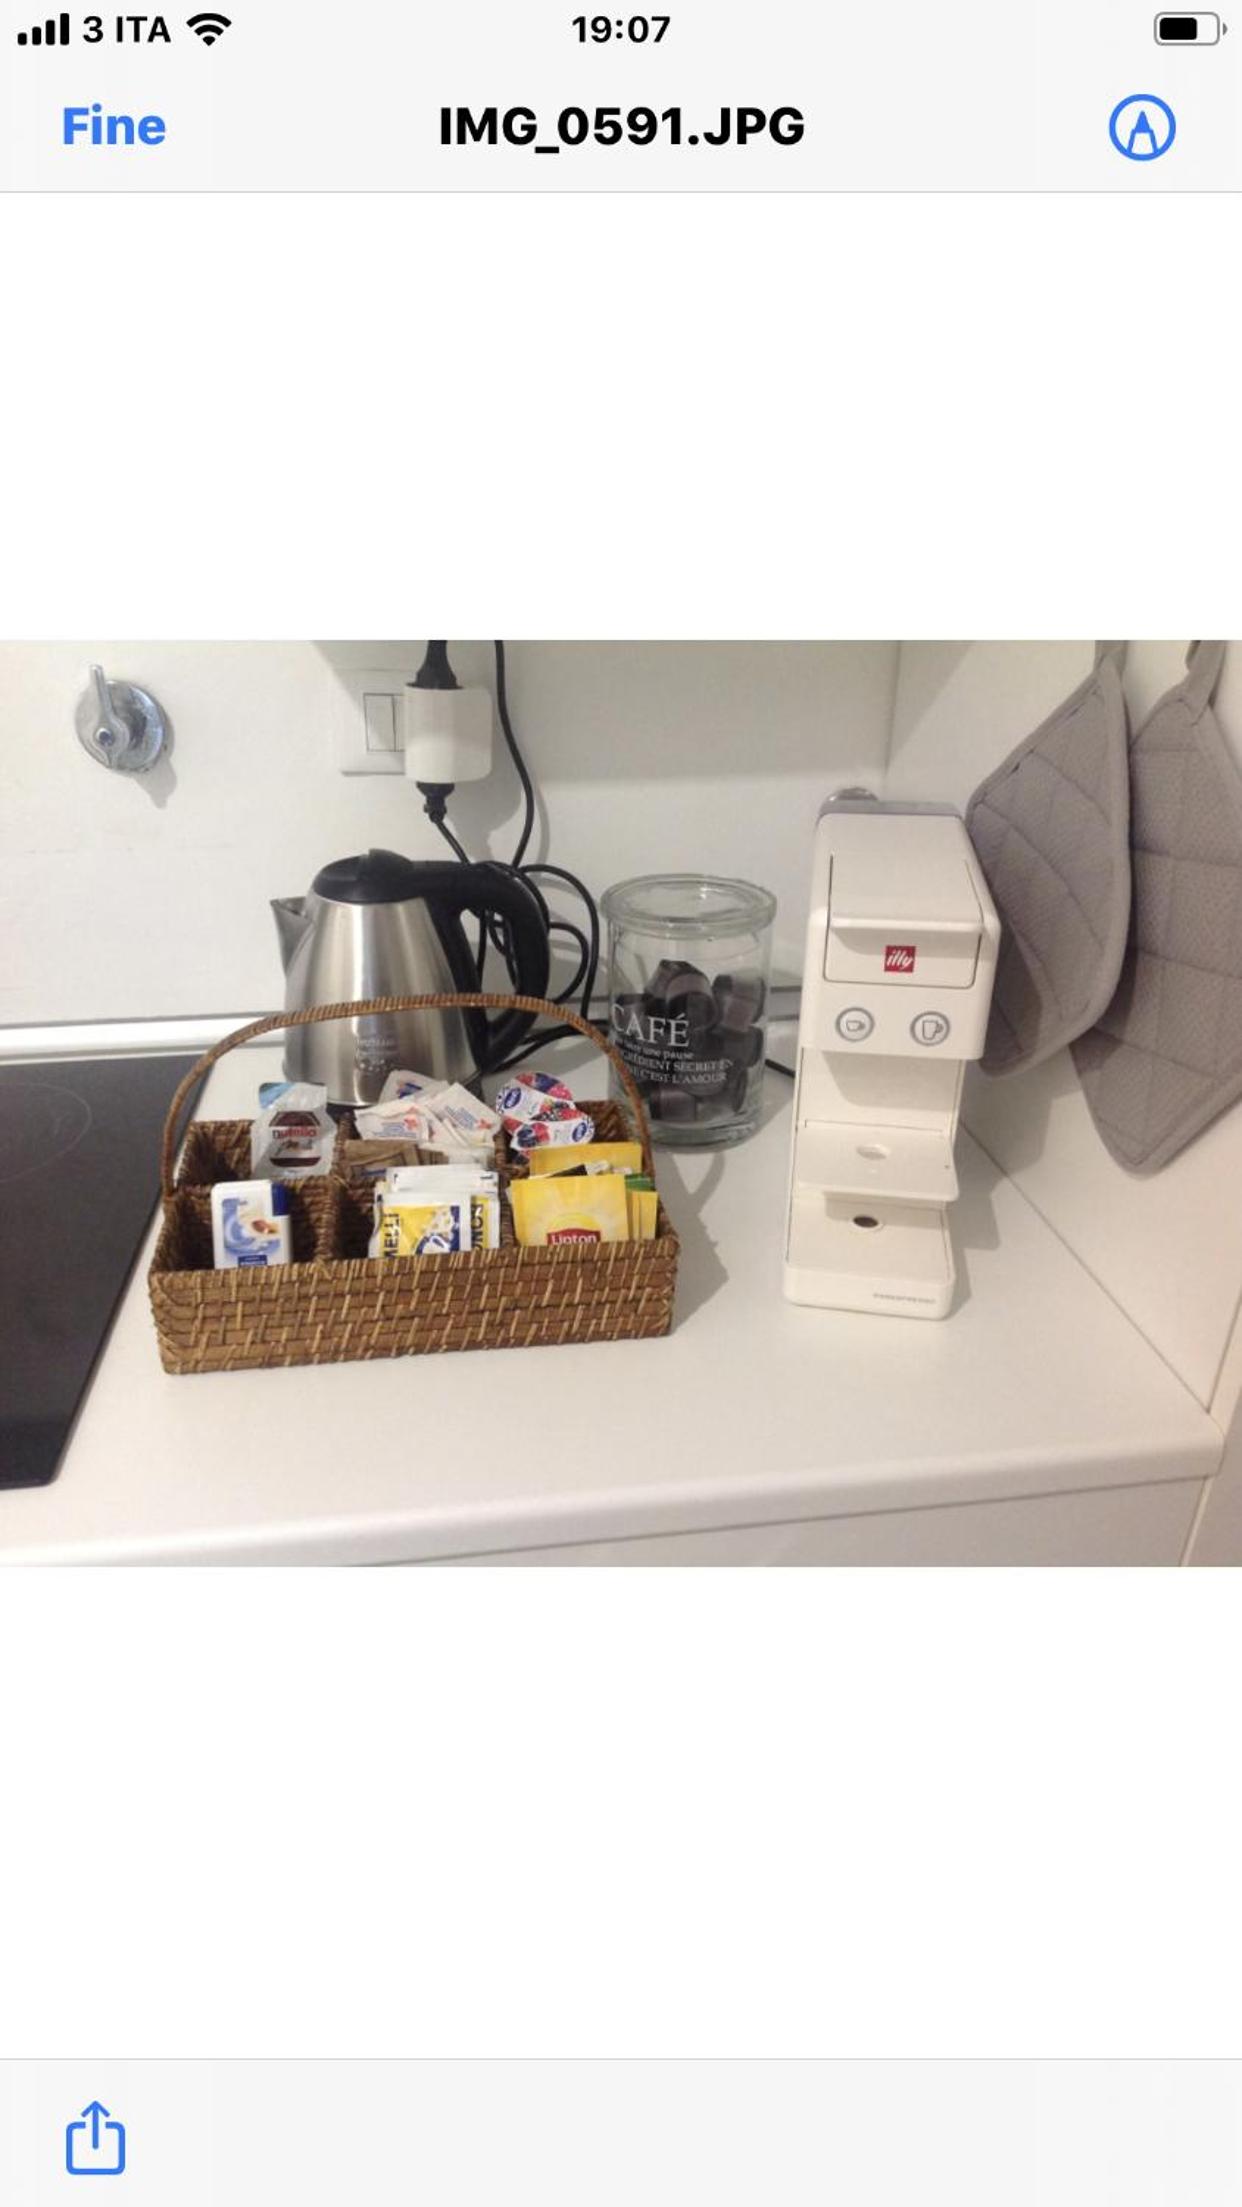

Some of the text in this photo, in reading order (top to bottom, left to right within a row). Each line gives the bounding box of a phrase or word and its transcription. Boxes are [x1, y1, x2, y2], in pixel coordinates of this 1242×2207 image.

[82, 15, 172, 44] 3 ITA
[572, 15, 671, 44] 19:07
[63, 104, 166, 146] Fine
[440, 106, 805, 154] IMG_0591.JPG
[886, 949, 914, 970] illy
[611, 1003, 690, 1047] CAFÉ
